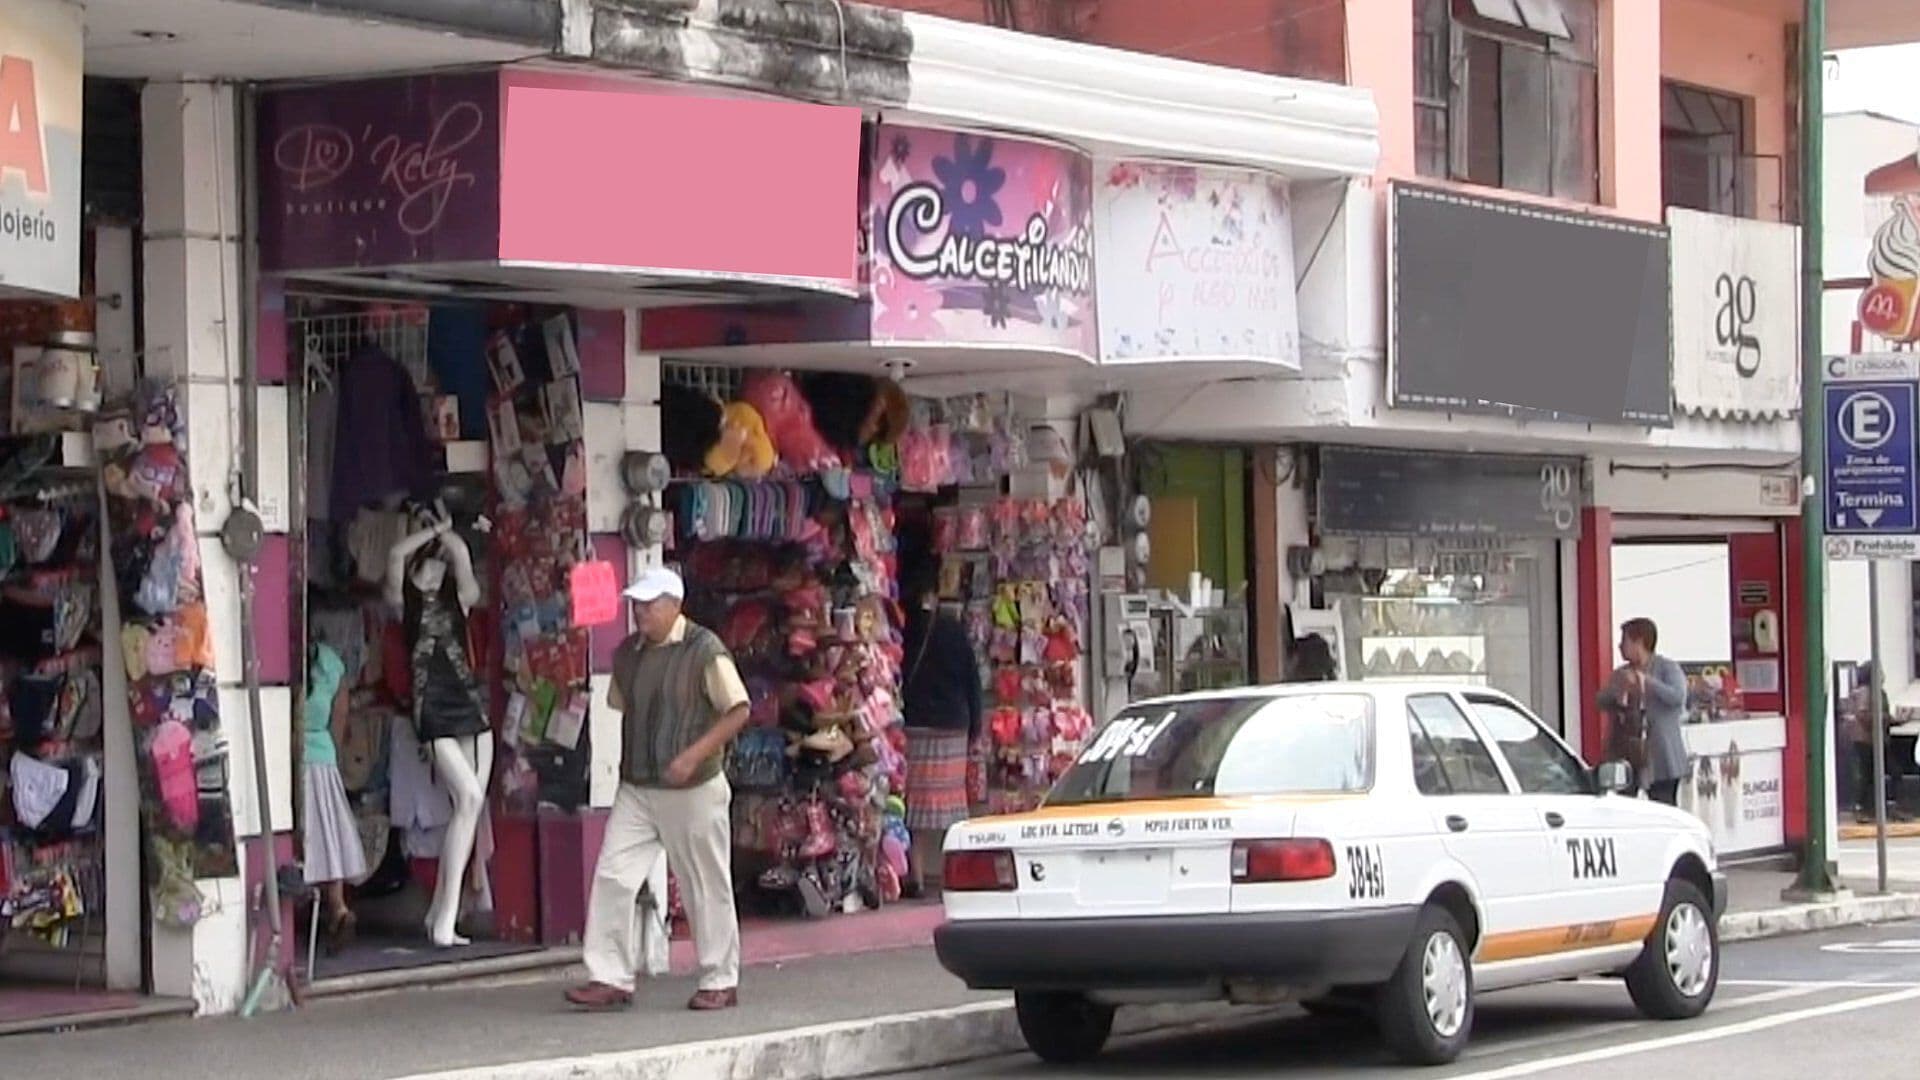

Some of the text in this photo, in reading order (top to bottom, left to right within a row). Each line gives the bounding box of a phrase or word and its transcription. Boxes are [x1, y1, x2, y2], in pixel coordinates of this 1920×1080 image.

[1715, 272, 1761, 378] ag
[1853, 400, 1881, 439] E
[1835, 490, 1904, 507] Termina
[1566, 837, 1618, 879] TAXI
